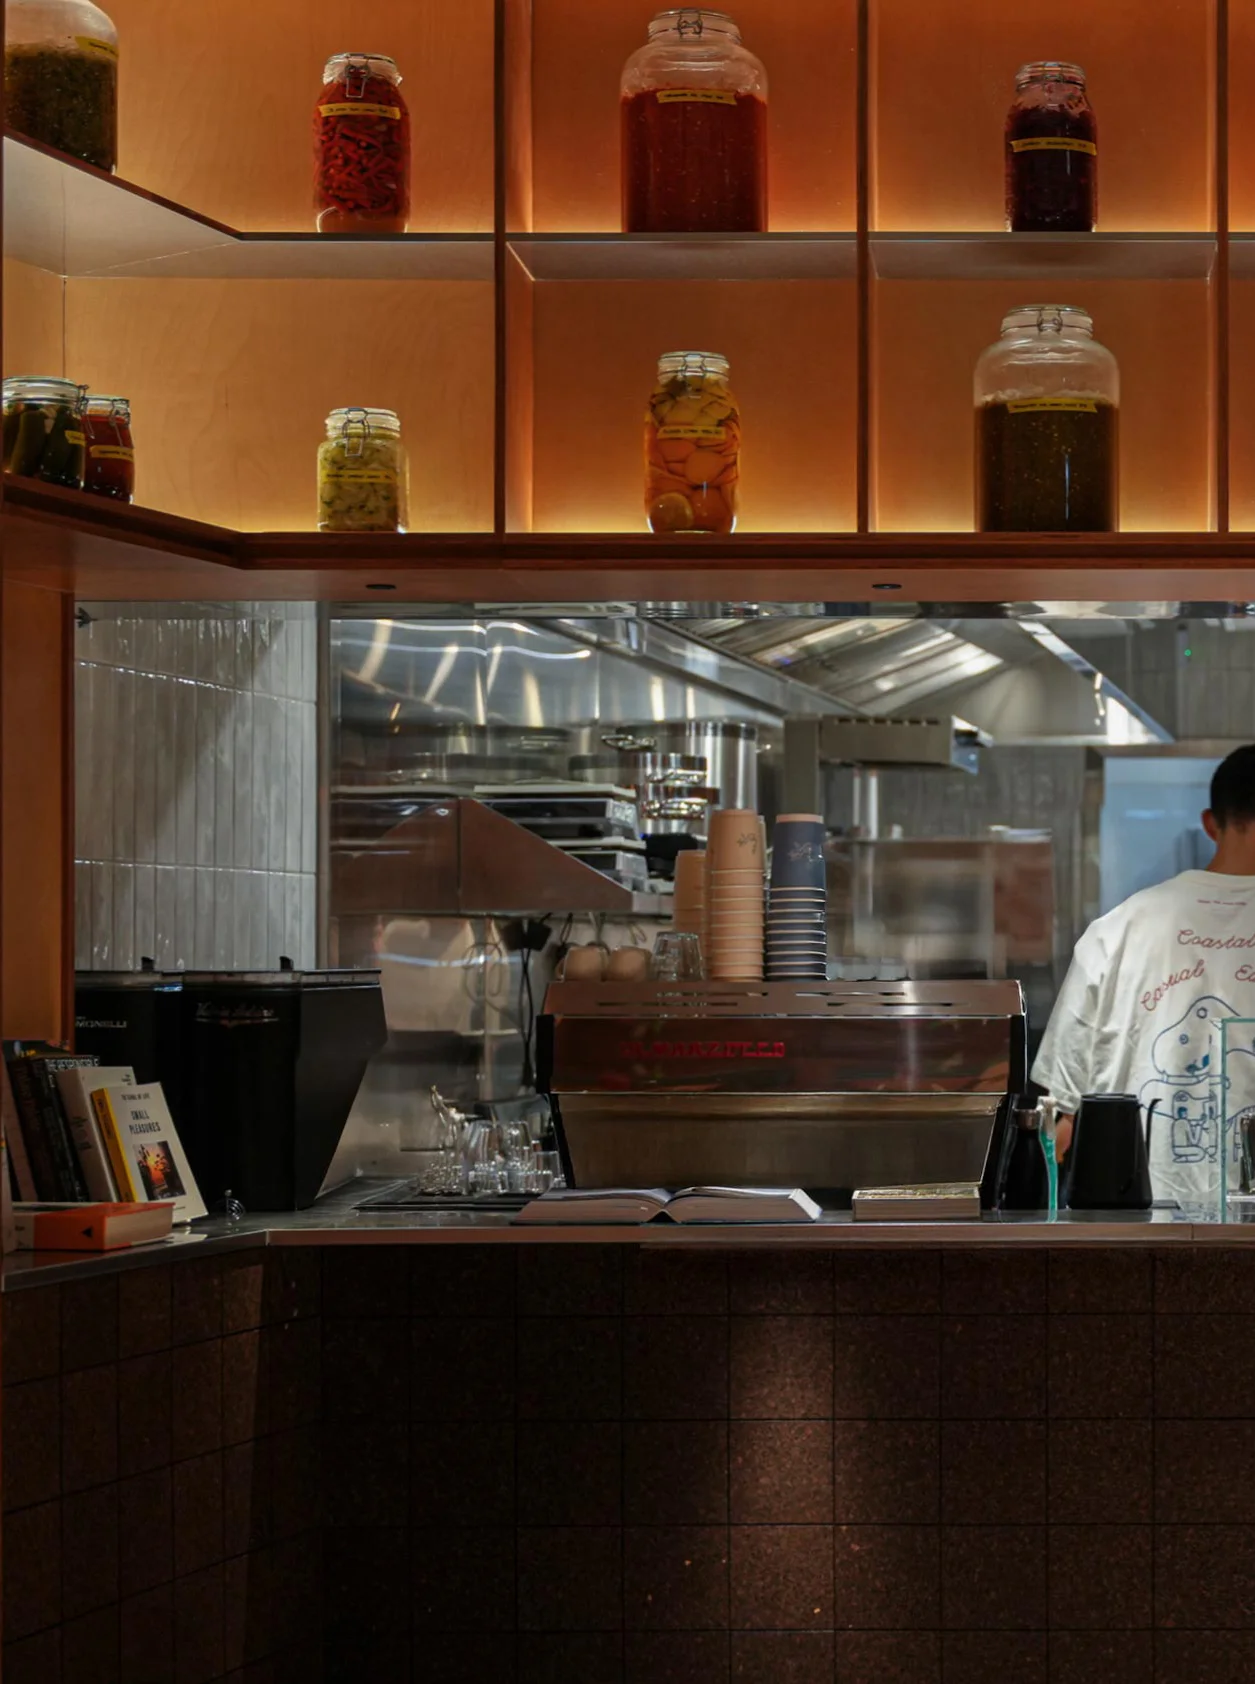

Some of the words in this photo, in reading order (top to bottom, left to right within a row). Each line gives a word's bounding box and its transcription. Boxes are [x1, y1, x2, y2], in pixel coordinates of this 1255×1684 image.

[1141, 959, 1205, 1011] Casual
[130, 1110, 149, 1120] SMALL
[128, 1122, 161, 1134] PLEASURES
